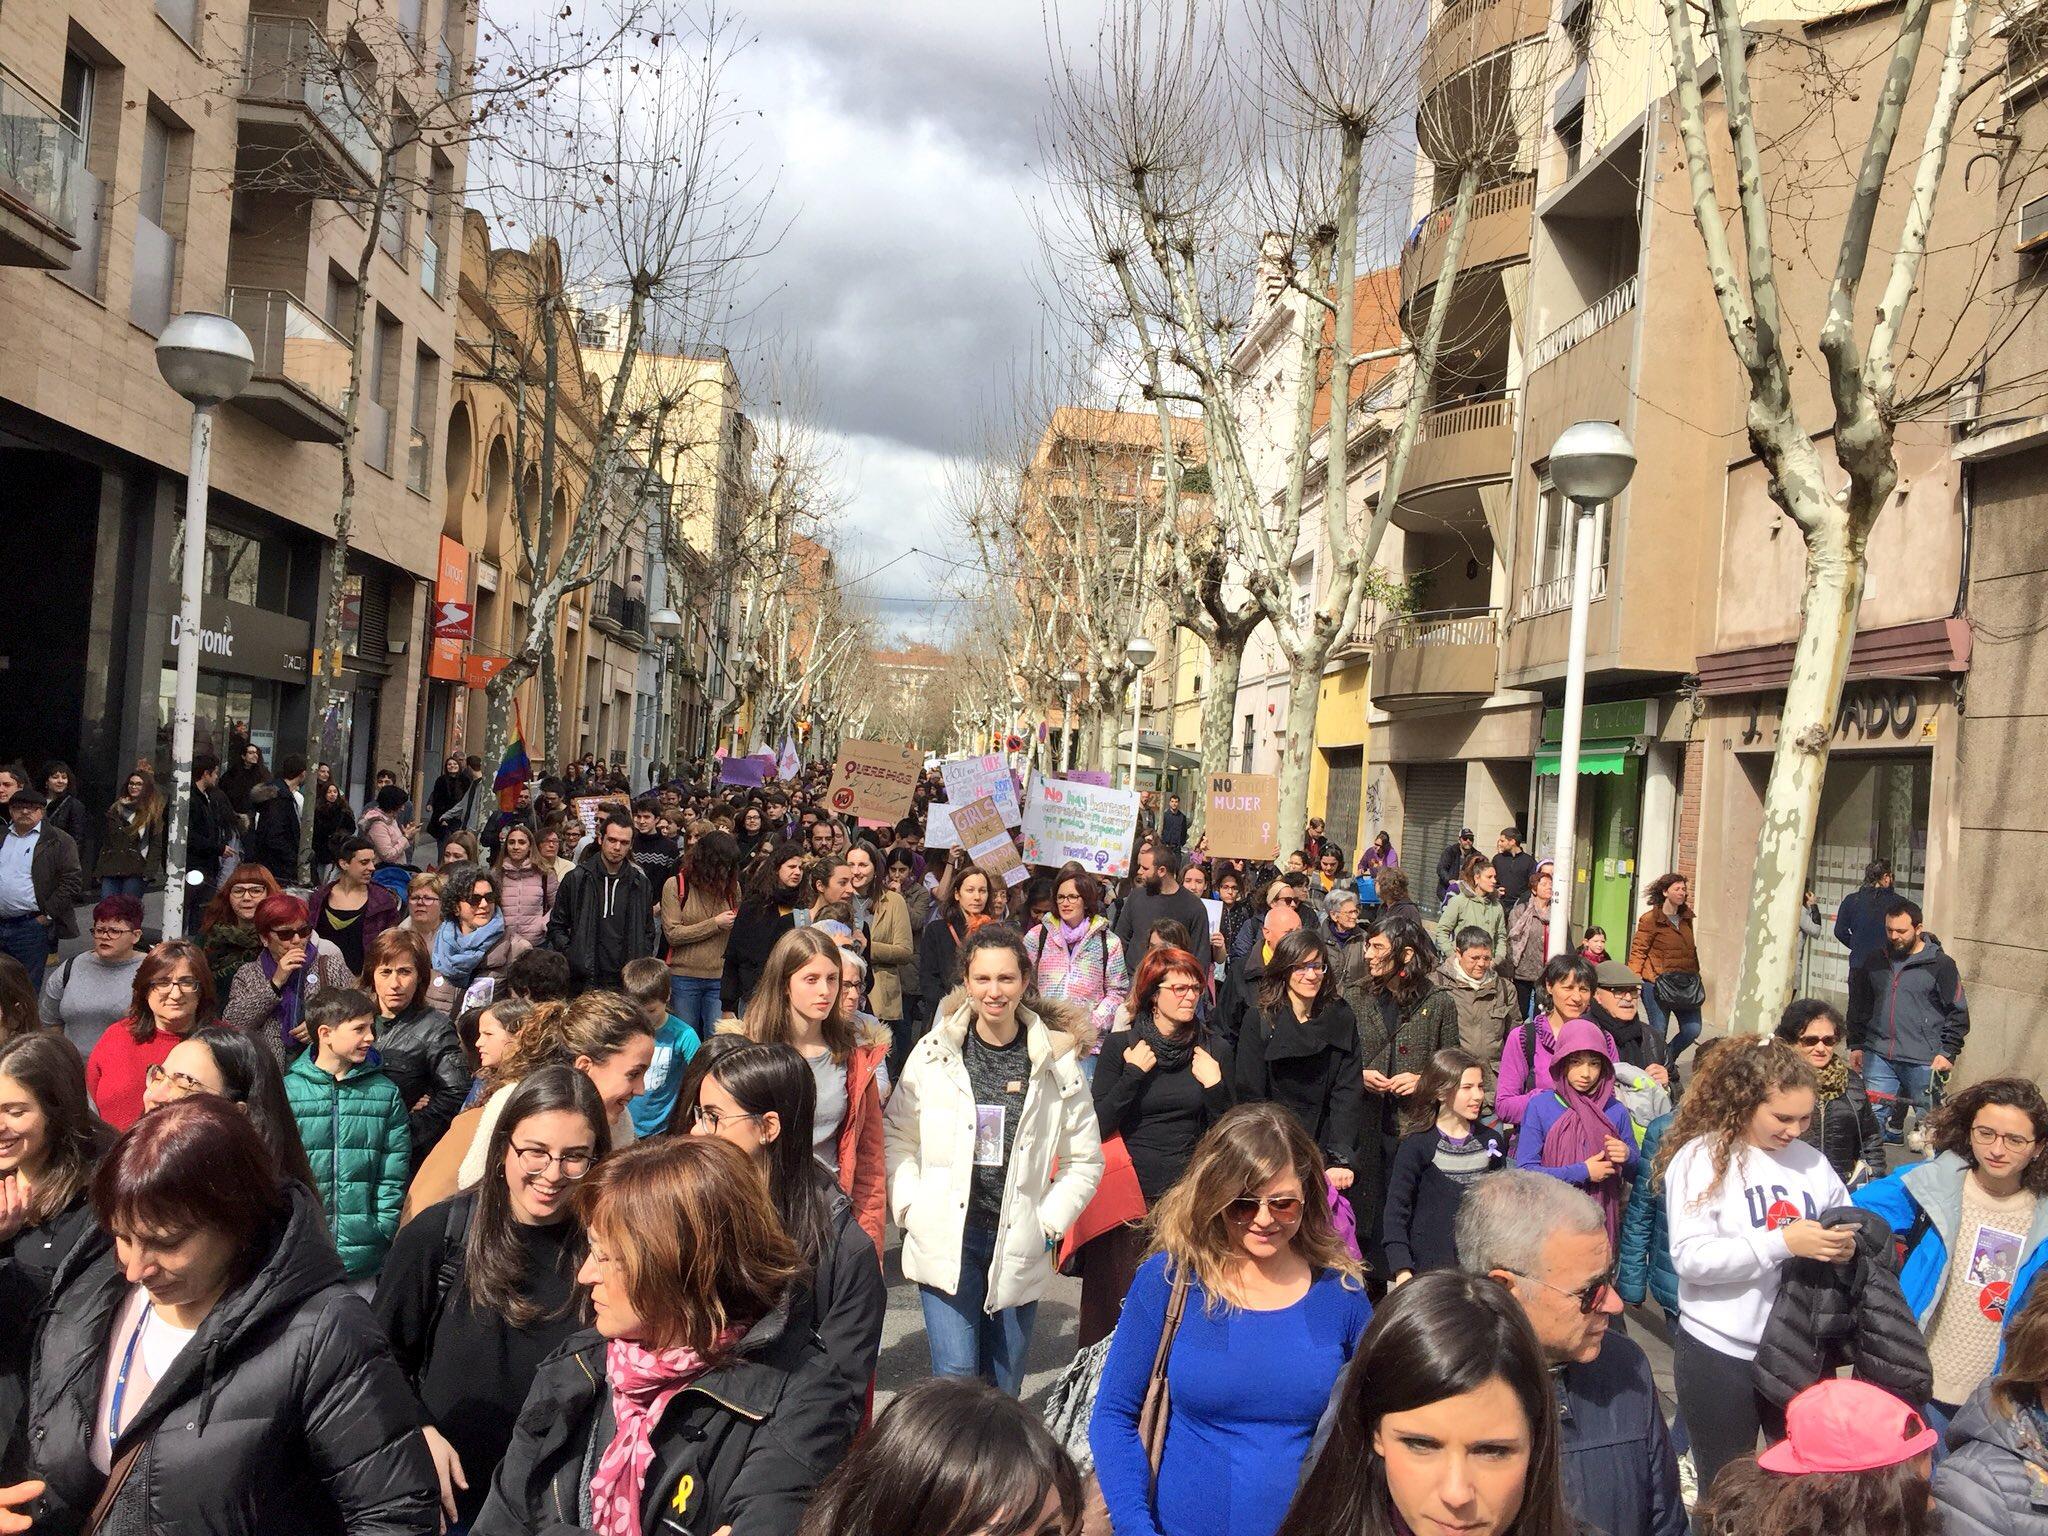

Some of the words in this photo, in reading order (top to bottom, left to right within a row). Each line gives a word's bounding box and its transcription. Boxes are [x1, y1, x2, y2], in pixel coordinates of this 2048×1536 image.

[171, 614, 234, 656] Dronic
[845, 761, 912, 786] QUEREMOS
[1213, 778, 1232, 792] NO
[1045, 787, 1062, 803] No
[1067, 791, 1087, 811] hay
[1214, 796, 1261, 811] MUJER
[954, 800, 996, 830] GIRLS
[1063, 846, 1093, 860] mente
